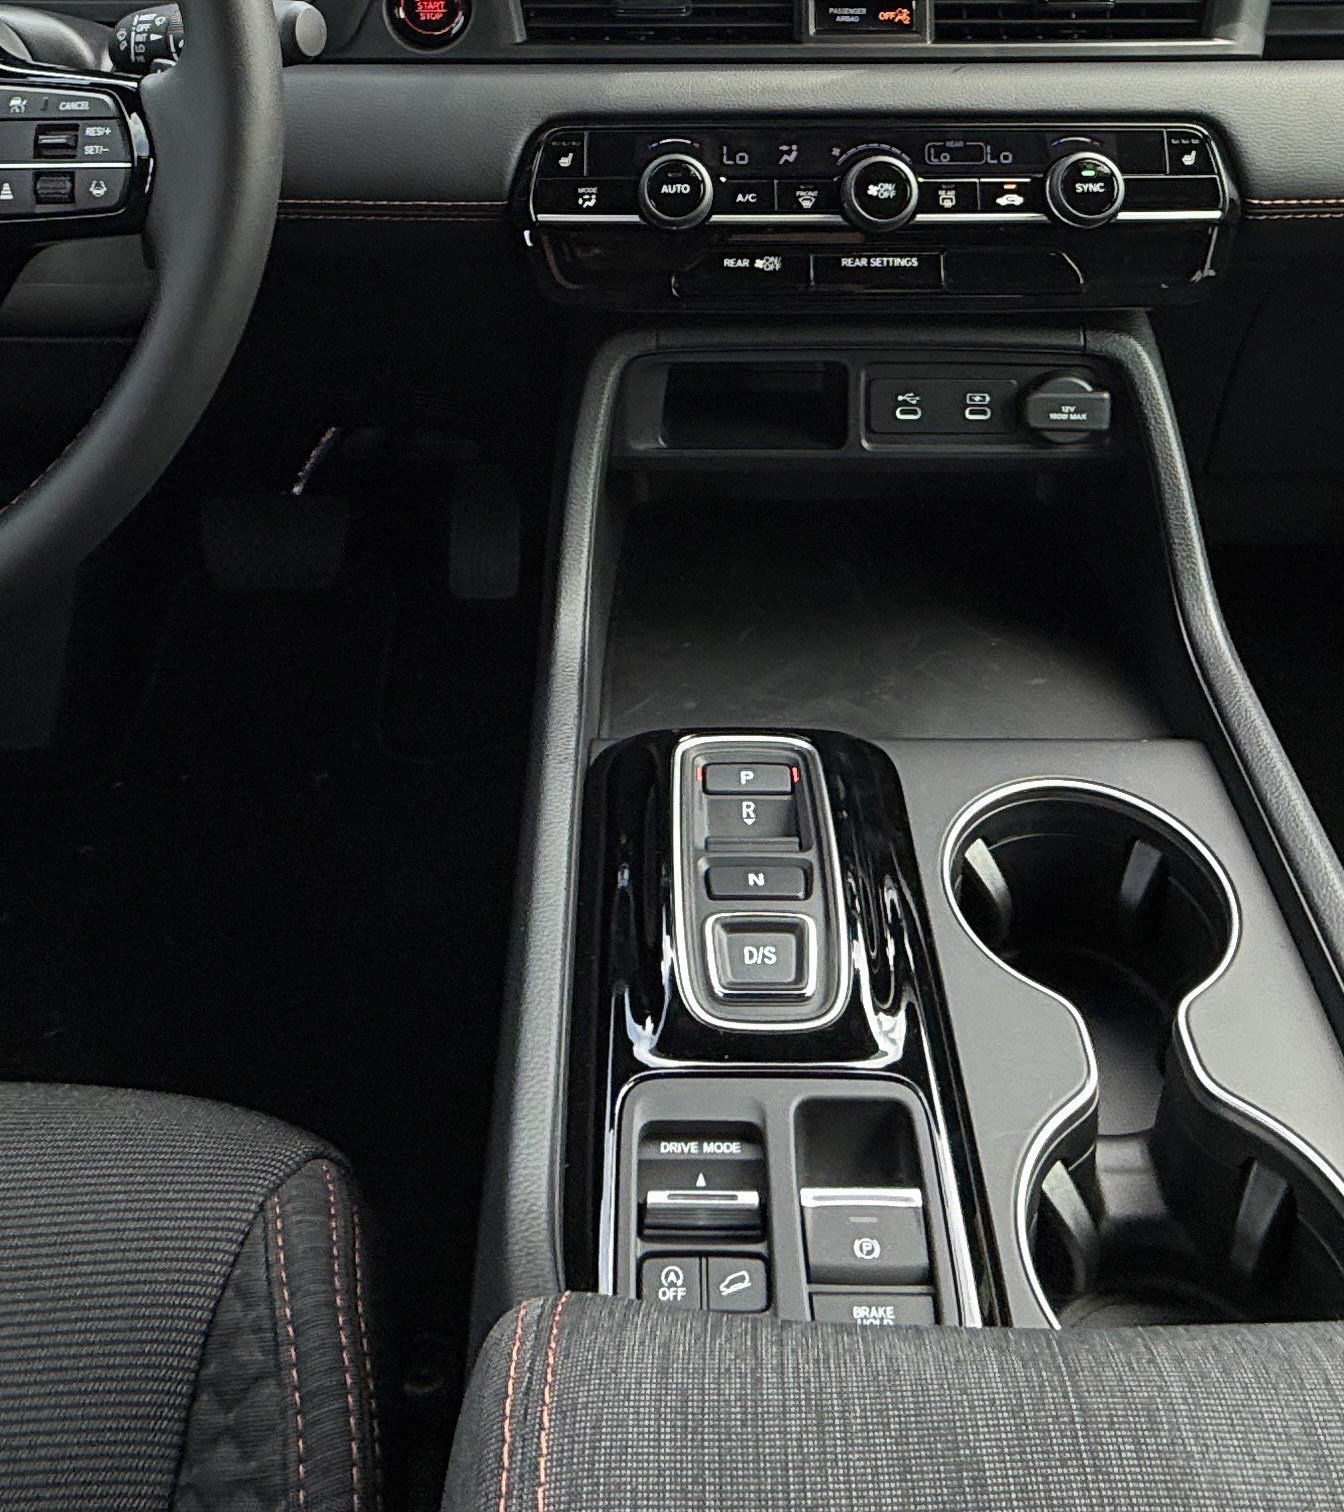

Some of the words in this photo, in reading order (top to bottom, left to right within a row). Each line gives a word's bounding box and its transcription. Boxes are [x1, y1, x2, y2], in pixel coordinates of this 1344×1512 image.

[878, 11, 896, 21] OFF
[661, 184, 691, 194] AUTO
[1075, 182, 1107, 193] SYNC
[736, 193, 757, 203] A/C
[877, 190, 896, 199] OFF
[723, 258, 750, 268] REAR
[841, 257, 867, 268] REAR
[869, 257, 919, 268] SETTINGS
[739, 770, 754, 786] P
[742, 801, 756, 819] R
[748, 873, 765, 886] N
[743, 946, 777, 965] D/S
[660, 1141, 699, 1154] DRIVE
[702, 1141, 742, 1154] MODE
[658, 1287, 687, 1301] OFF
[852, 1306, 895, 1319] BRAKE
